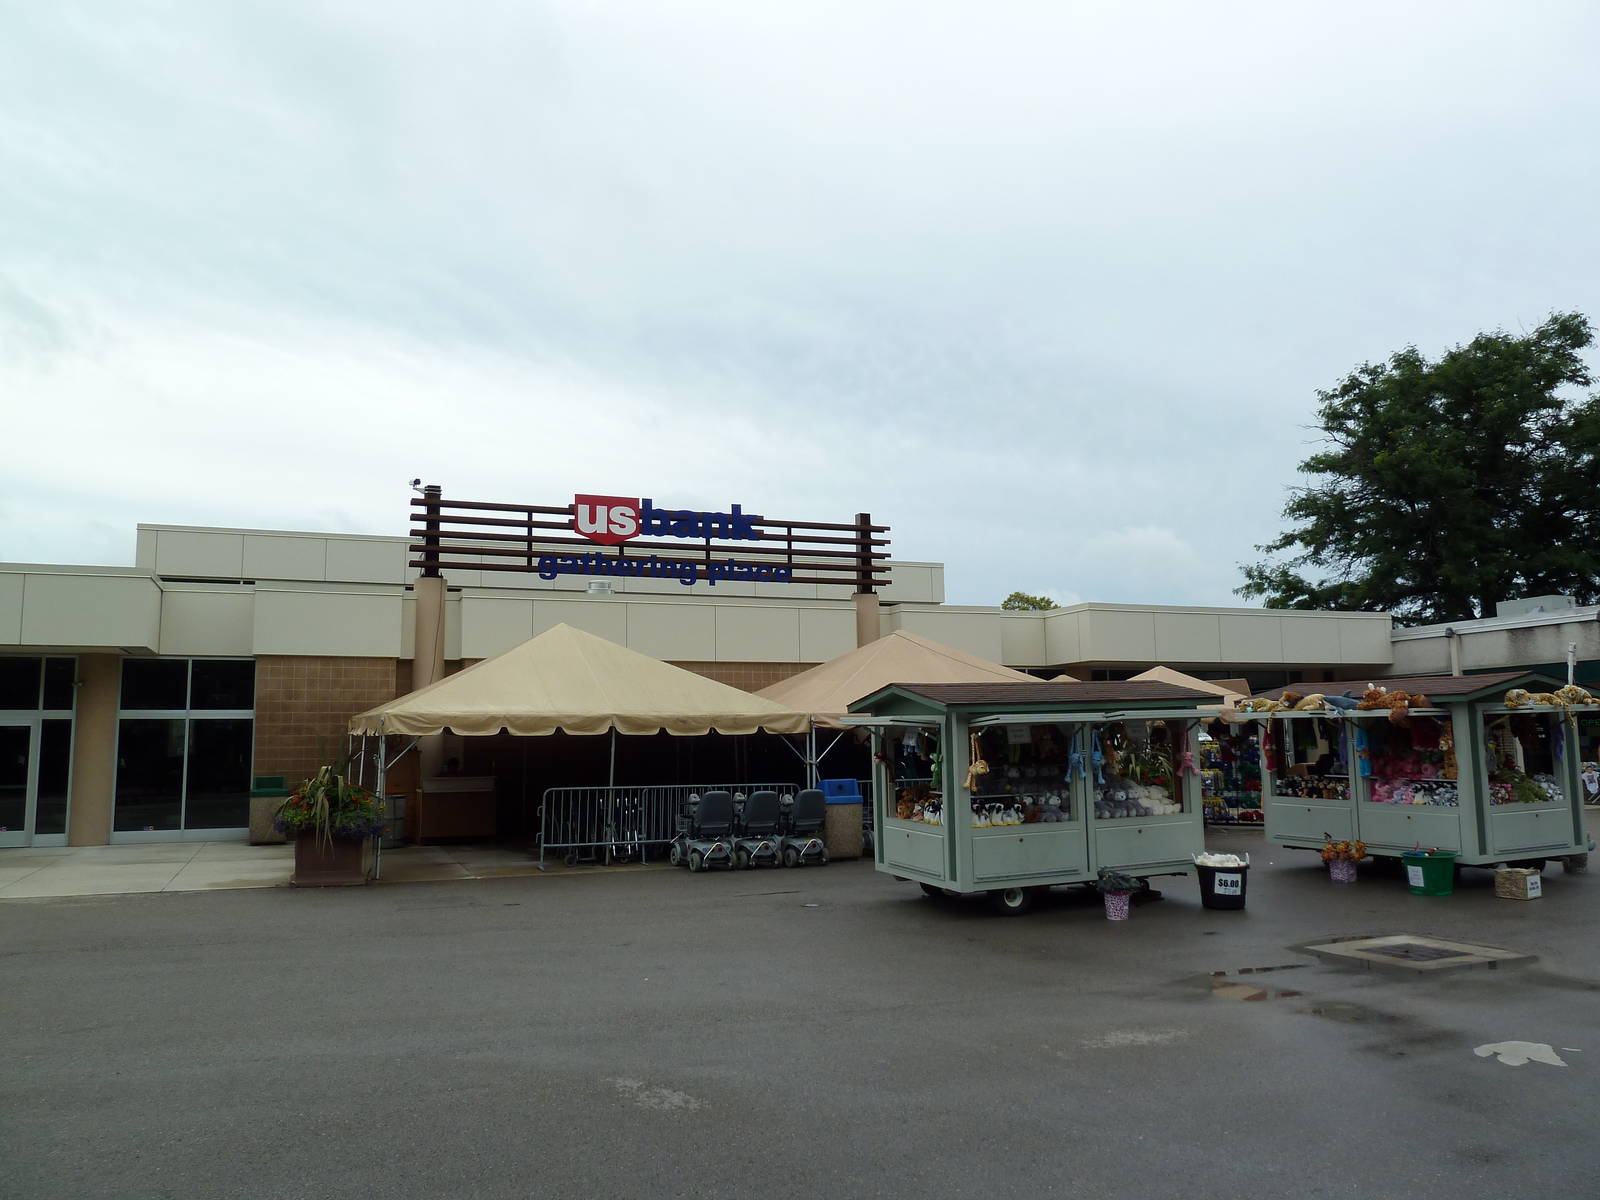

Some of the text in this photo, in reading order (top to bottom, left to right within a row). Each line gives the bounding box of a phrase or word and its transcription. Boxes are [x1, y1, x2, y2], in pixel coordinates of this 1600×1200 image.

[577, 498, 759, 541] us bank
[538, 552, 792, 586] gathering place
